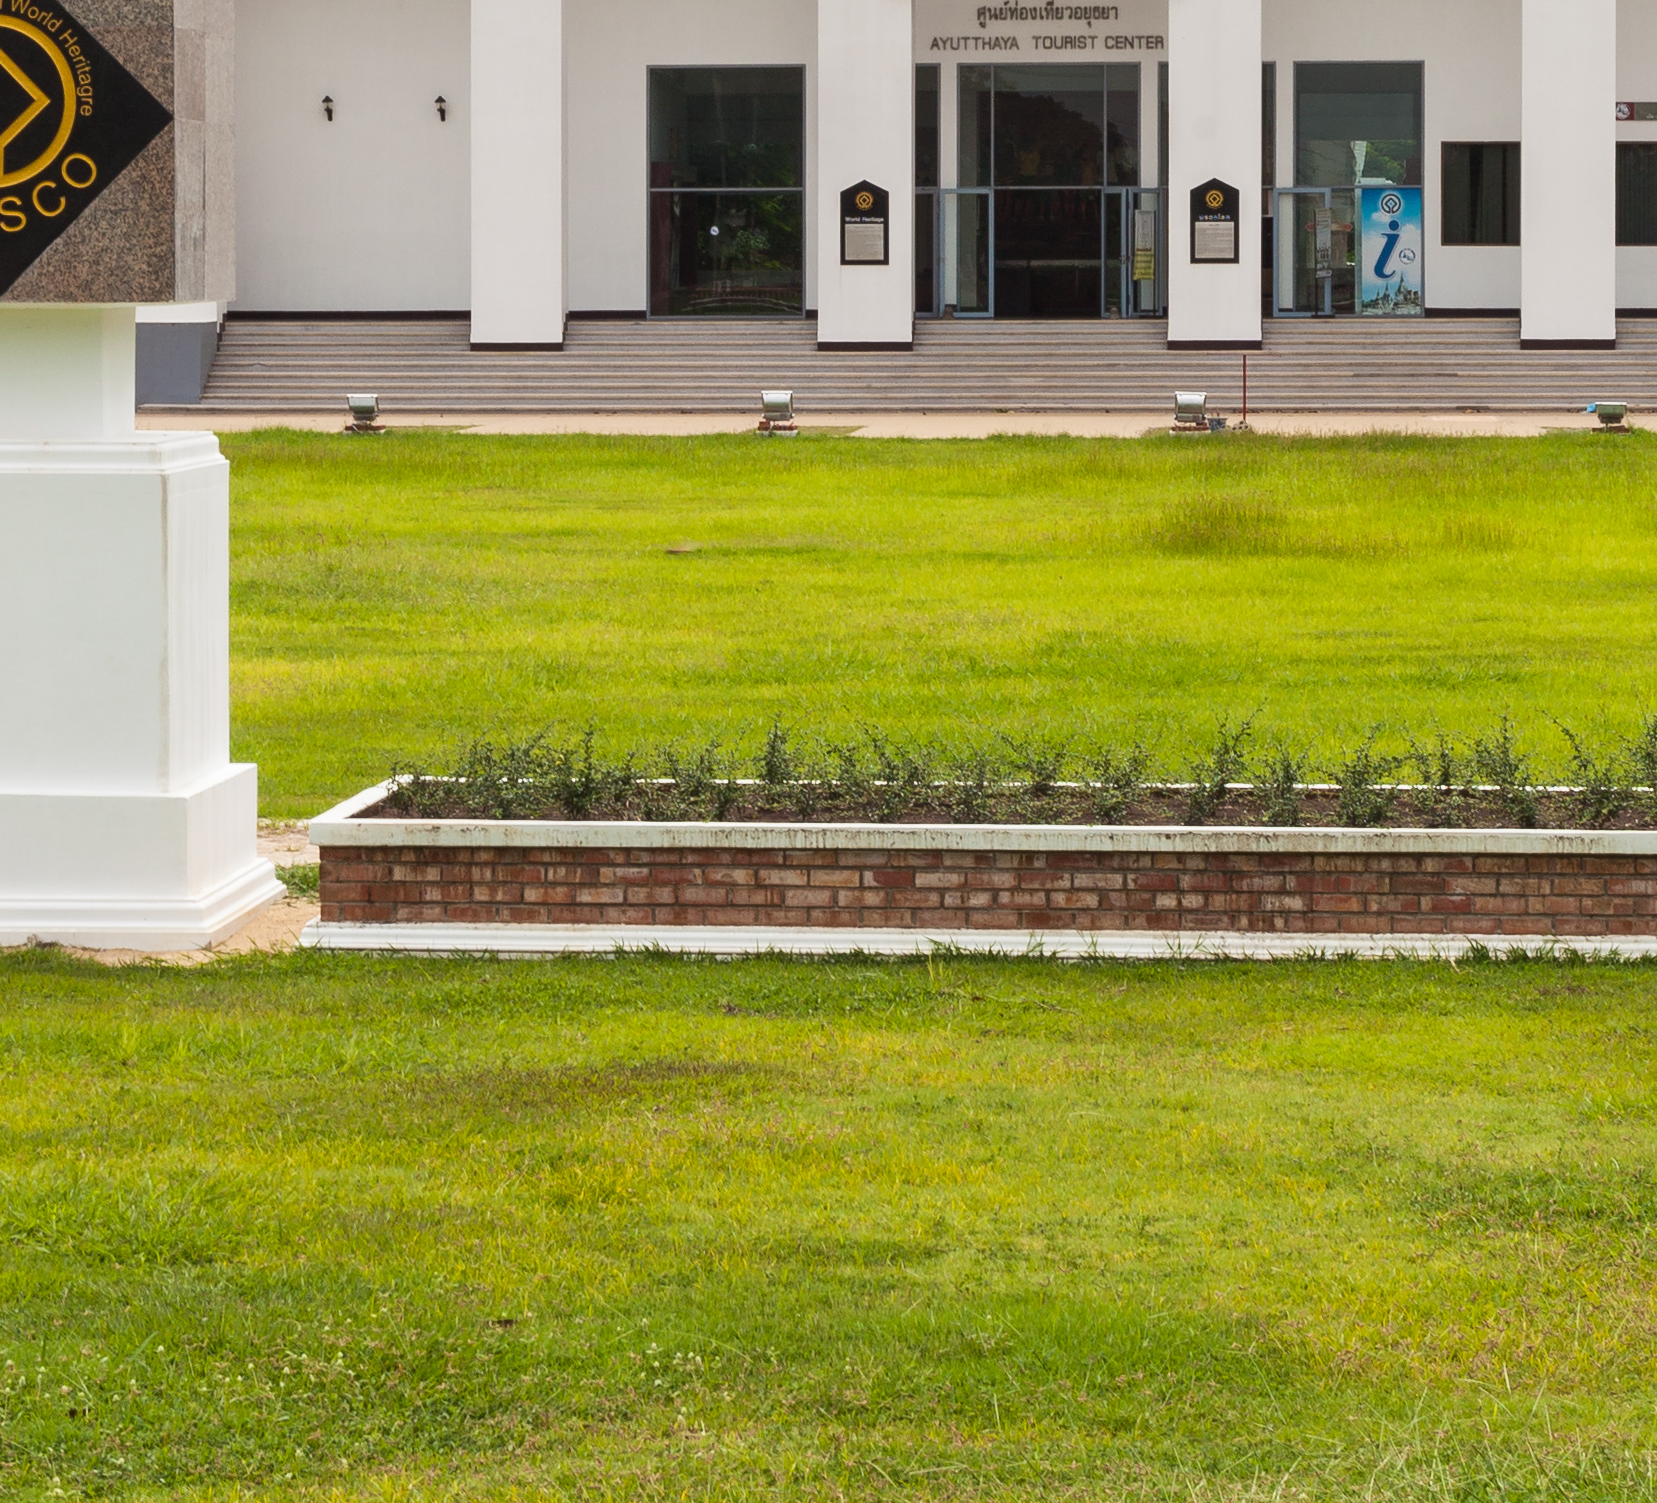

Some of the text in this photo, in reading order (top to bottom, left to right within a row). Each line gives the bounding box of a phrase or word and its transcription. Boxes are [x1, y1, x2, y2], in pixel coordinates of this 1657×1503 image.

[930, 35, 1164, 50] AYUTTHAYA TOURIST CENTER
[58, 29, 93, 116] Heritagre
